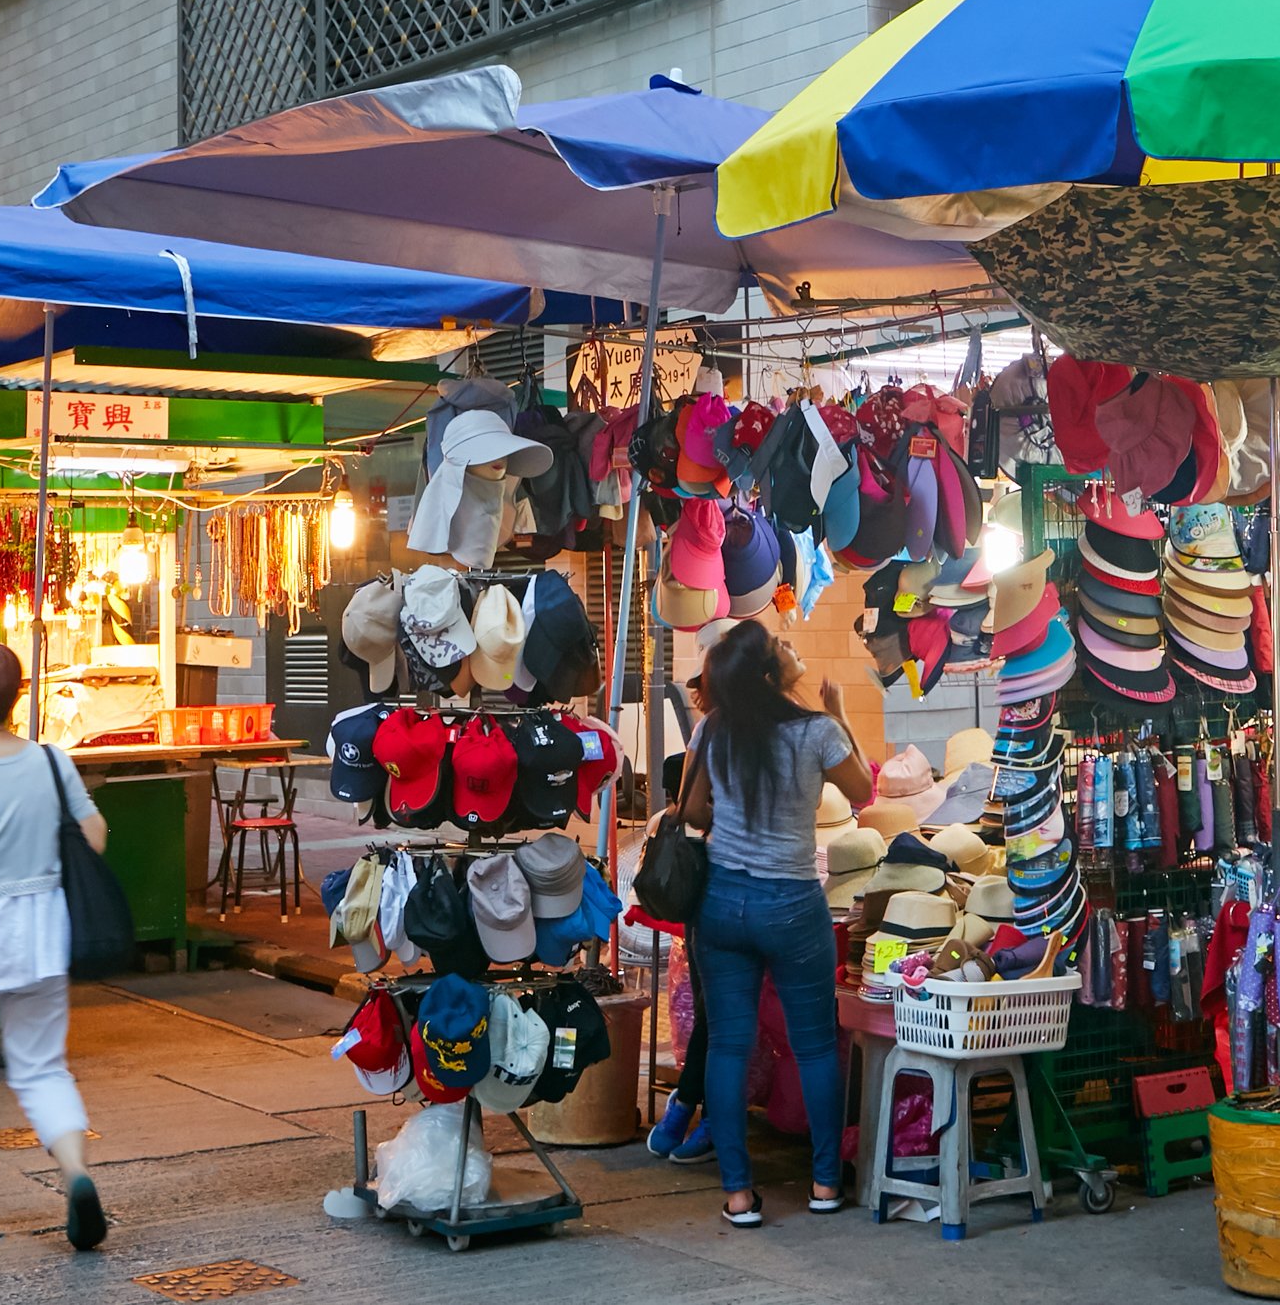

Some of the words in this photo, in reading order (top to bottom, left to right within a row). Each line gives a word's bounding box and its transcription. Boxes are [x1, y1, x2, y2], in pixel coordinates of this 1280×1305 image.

[583, 353, 597, 372] Ta
[606, 346, 641, 367] Yuen
[655, 332, 689, 357] treet
[609, 374, 642, 399] 太原
[67, 400, 134, 432] 寶興
